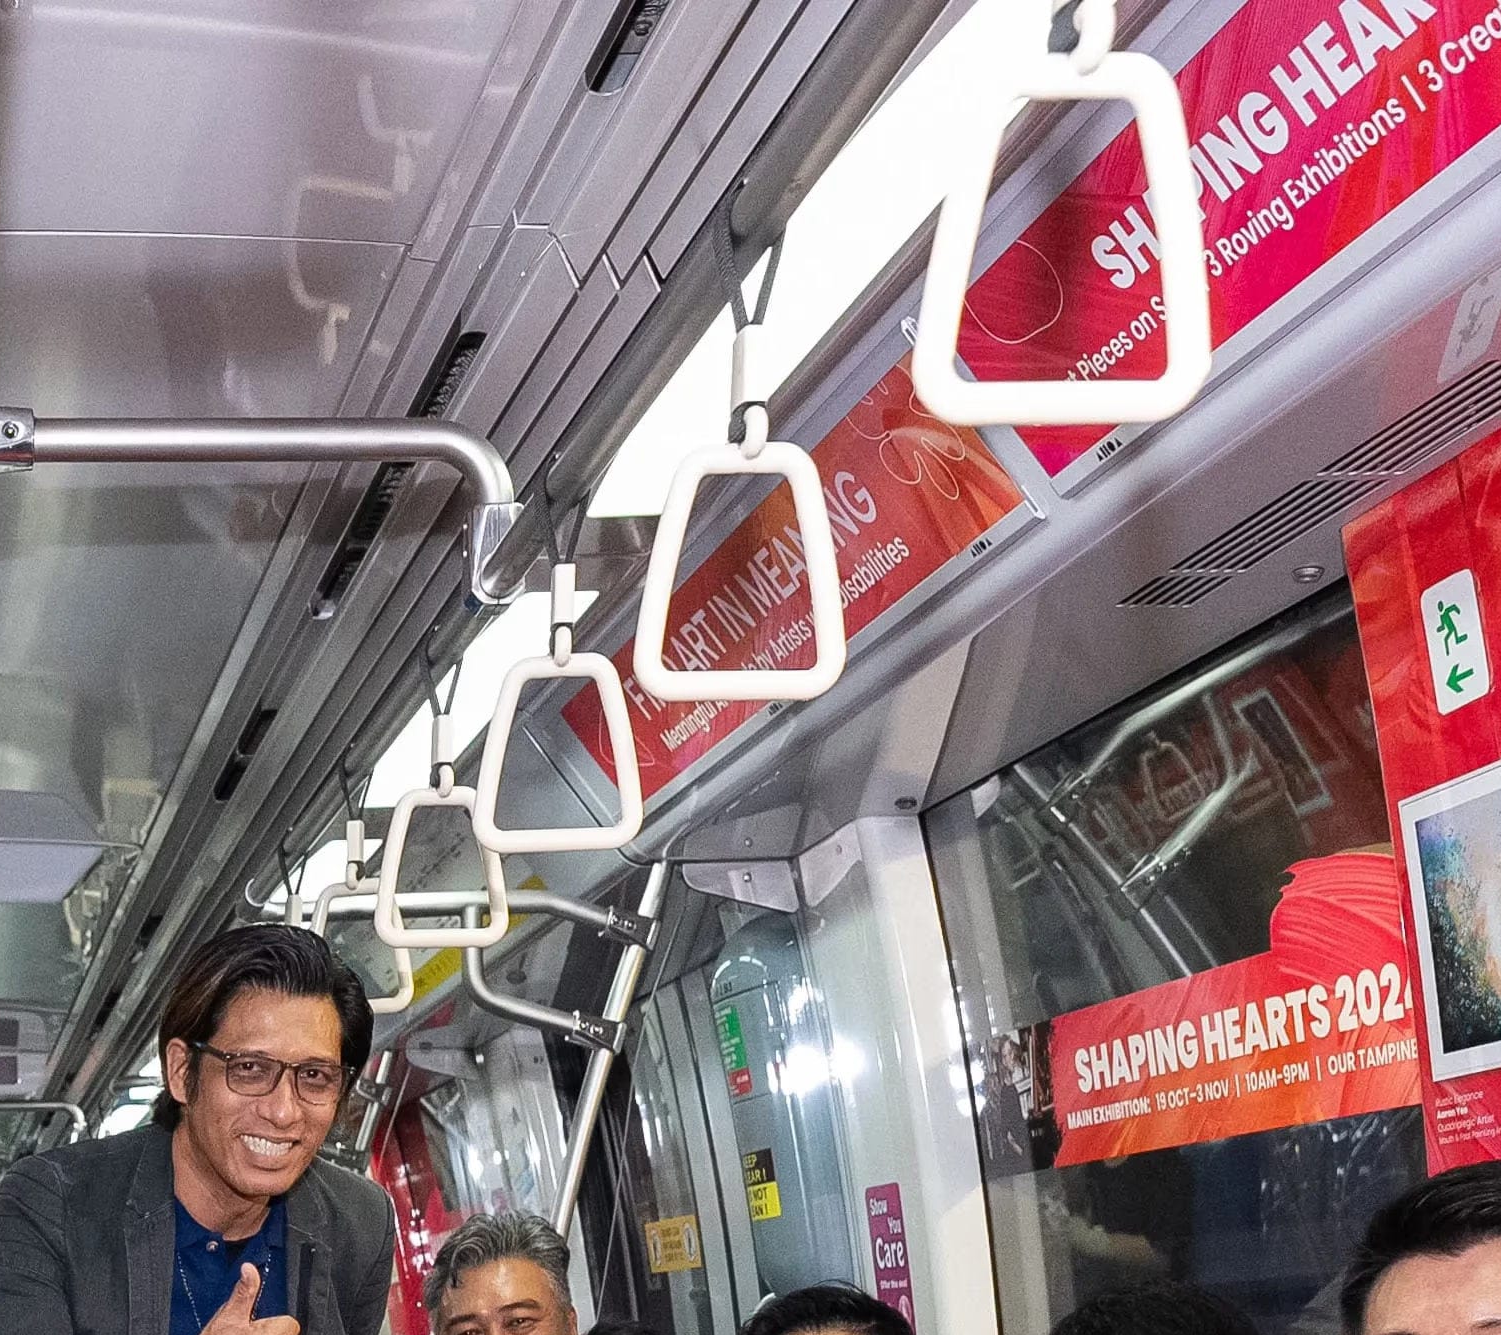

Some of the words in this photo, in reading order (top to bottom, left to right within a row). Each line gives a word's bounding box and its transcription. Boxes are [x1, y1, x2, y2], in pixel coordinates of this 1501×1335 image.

[1091, 91, 1289, 288] SHING
[1203, 248, 1223, 277] 3
[1216, 200, 1295, 265] Roving
[1292, 98, 1406, 209] Exhibitions
[1417, 59, 1443, 92] 3
[1075, 331, 1134, 380] Pieces
[1129, 311, 1158, 340] on
[707, 584, 757, 643] IN
[772, 616, 813, 664] Artists
[1074, 1019, 1199, 1093] SHAPING
[1202, 983, 1331, 1064] HEARTS
[1067, 1109, 1093, 1131] MAIN
[1094, 1095, 1152, 1124] EXHIBITION:
[1154, 1092, 1167, 1111] 19
[1204, 1078, 1230, 1101] NOV
[1327, 1048, 1357, 1077] OUR
[1358, 1035, 1418, 1069] TAMPINE
[875, 1237, 905, 1270] Care
